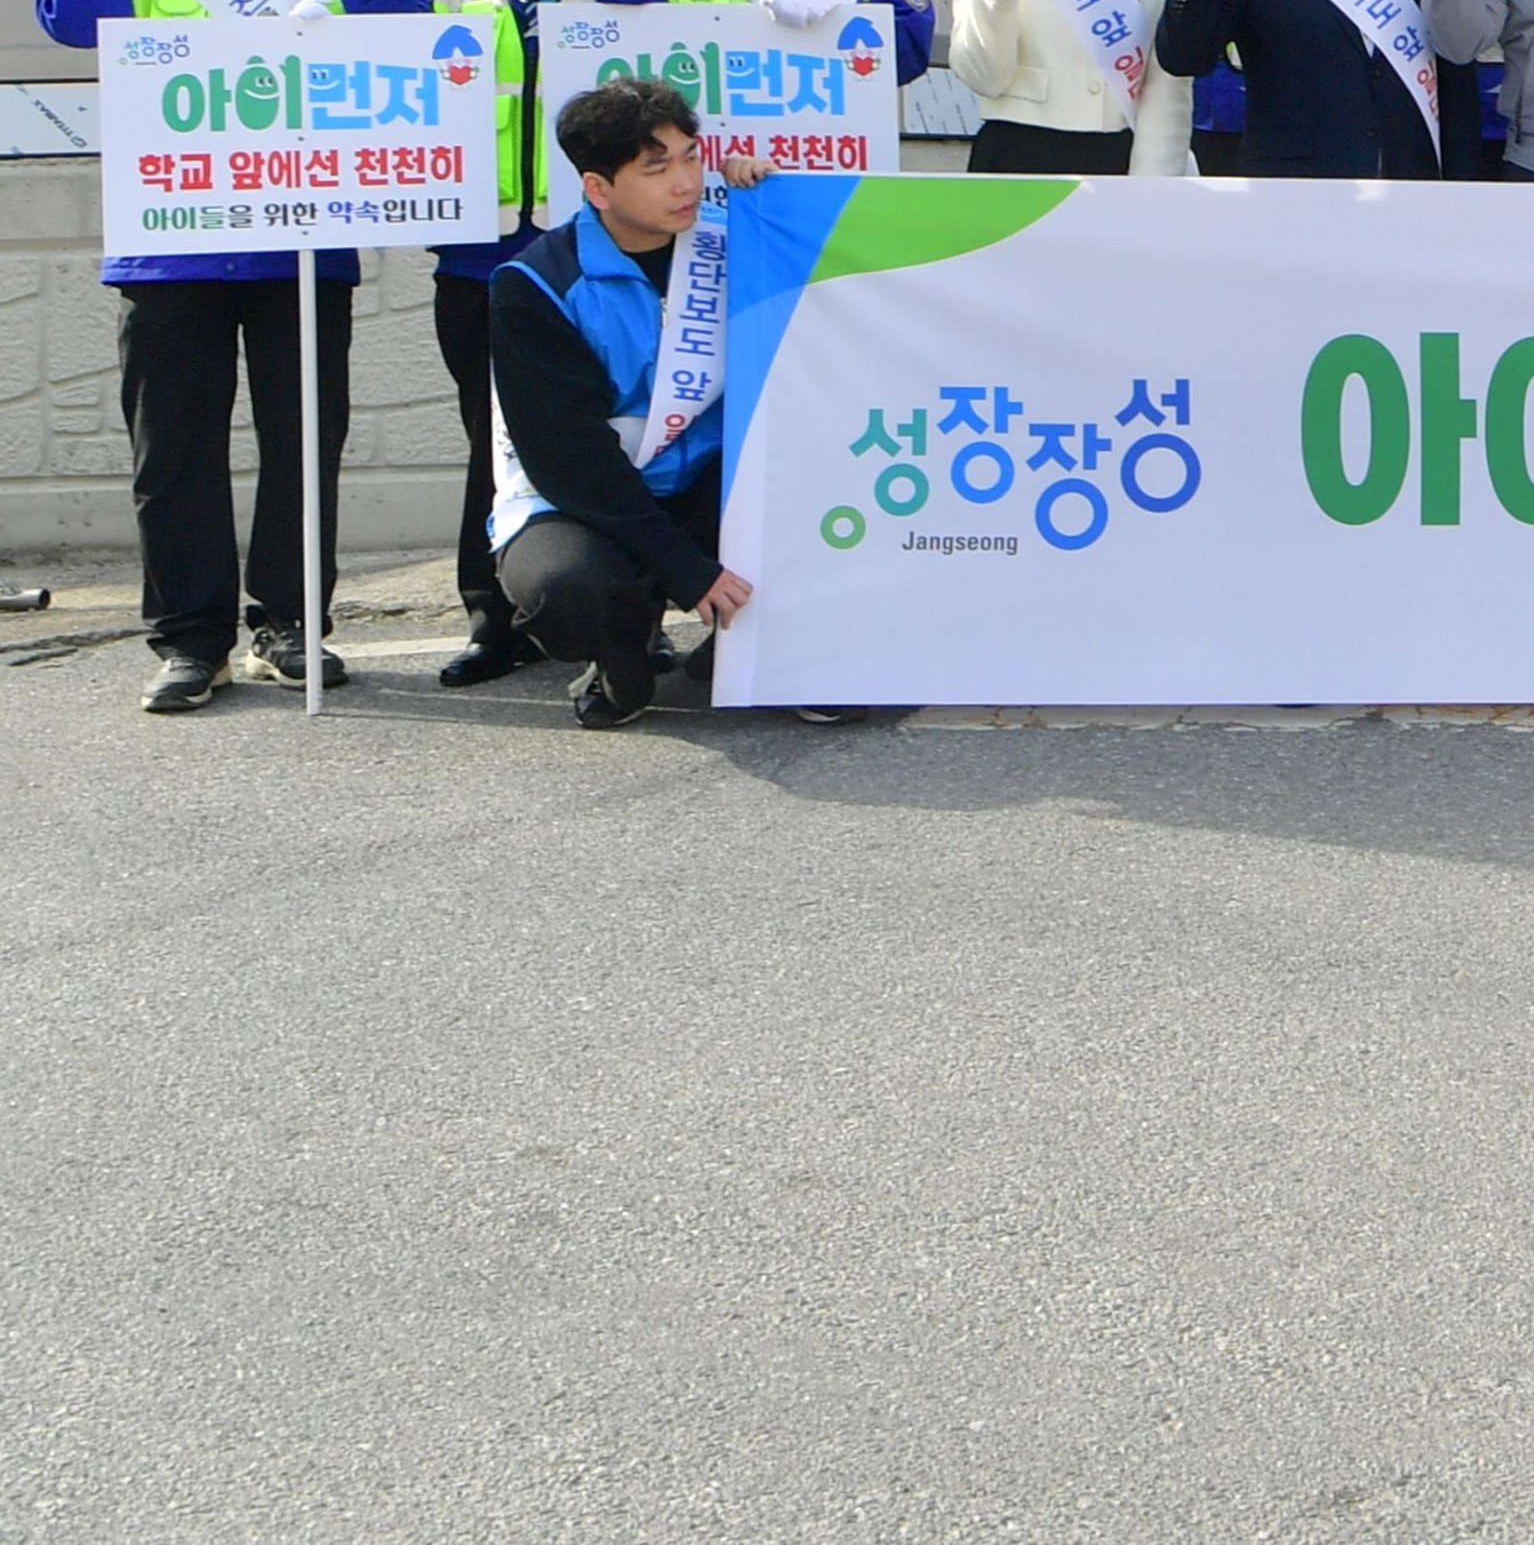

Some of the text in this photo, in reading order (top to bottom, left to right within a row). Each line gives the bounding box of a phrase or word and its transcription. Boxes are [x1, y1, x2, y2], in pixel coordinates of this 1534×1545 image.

[1091, 10, 1133, 48] 앞
[1394, 26, 1426, 63] 앞
[161, 54, 439, 133] 아이먼저
[138, 145, 463, 192] 학교 앞에선 천천히
[769, 135, 867, 171] 천천히
[142, 197, 464, 231] 아이들을 위한 약속입니다
[675, 231, 726, 357] 횡단보도
[672, 370, 713, 403] 앞
[820, 378, 1201, 551] 성장장성
[901, 530, 1019, 557] Jangseong
